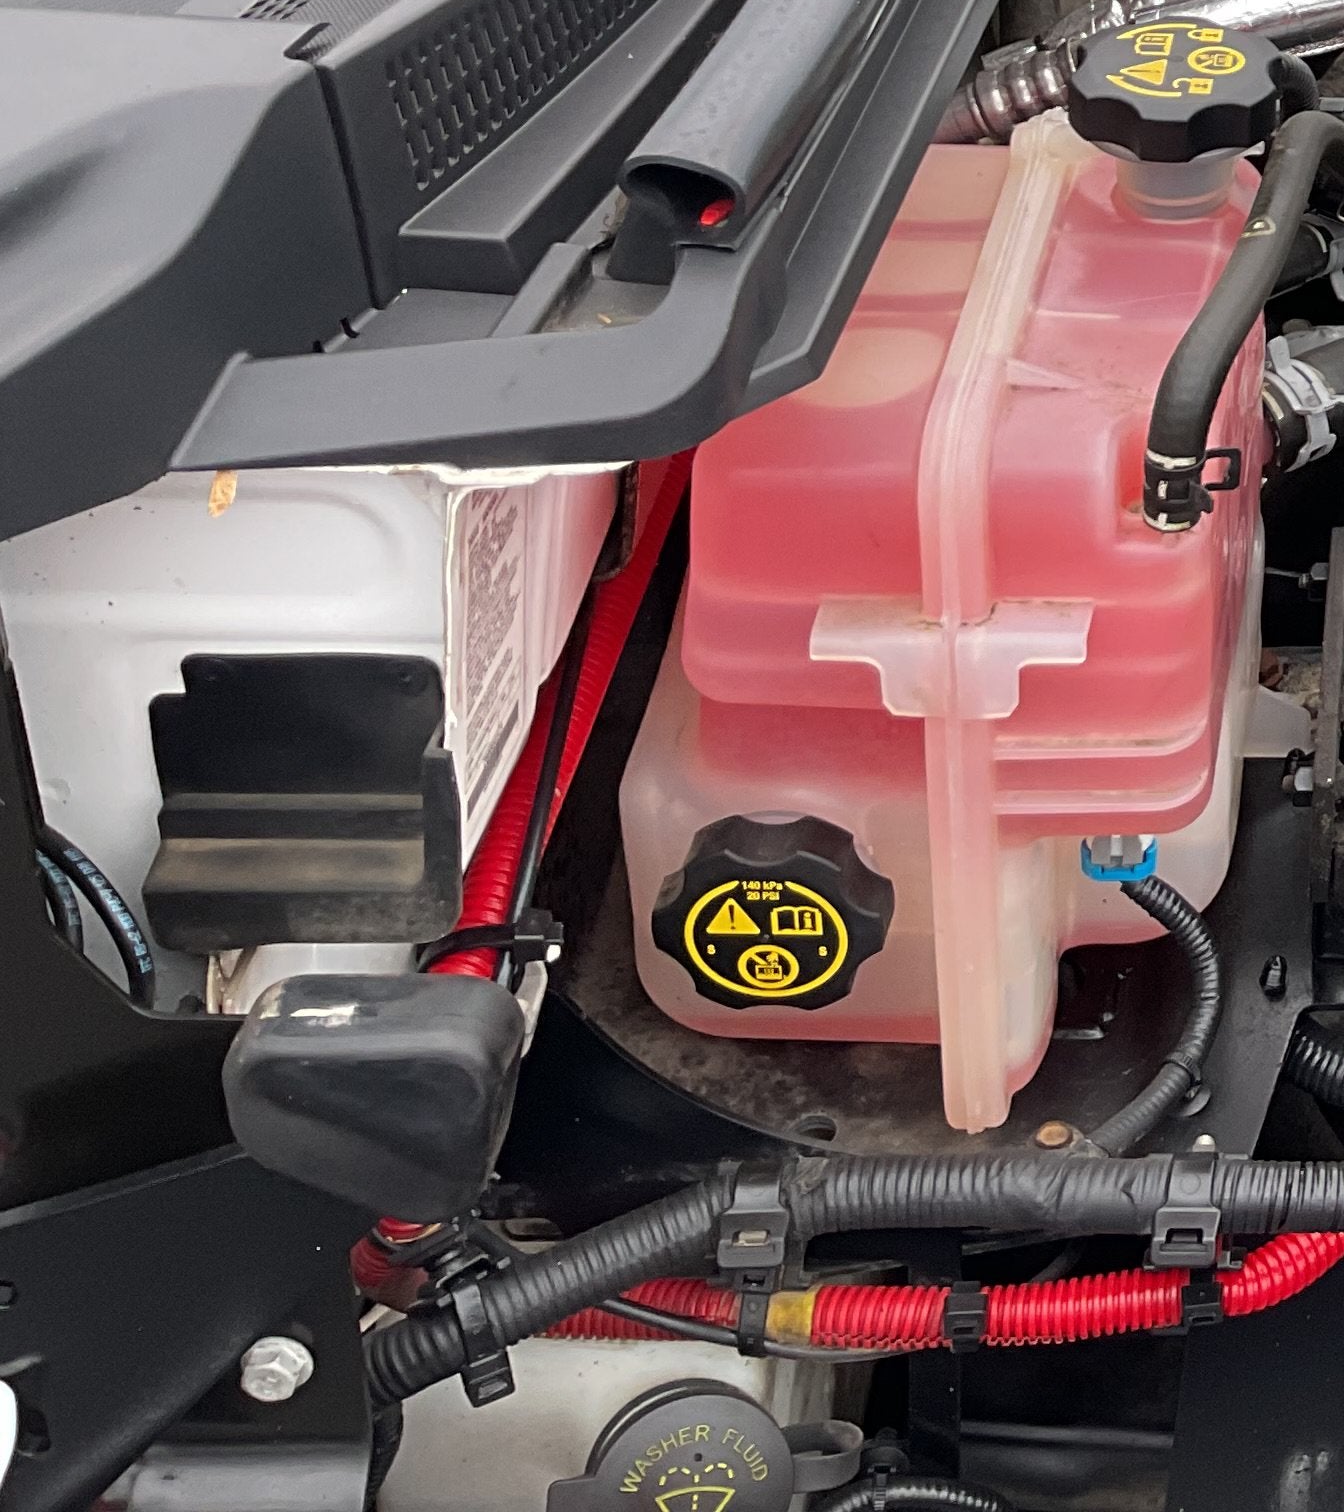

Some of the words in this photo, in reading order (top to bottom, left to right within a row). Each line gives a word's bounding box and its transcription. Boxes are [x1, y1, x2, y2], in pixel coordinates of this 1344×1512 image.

[741, 880, 761, 891] 140
[762, 880, 783, 891] kPa
[746, 891, 761, 901] 20
[761, 891, 780, 901] PSI
[619, 1423, 711, 1493] WASHER
[721, 1427, 769, 1482] FLUID
